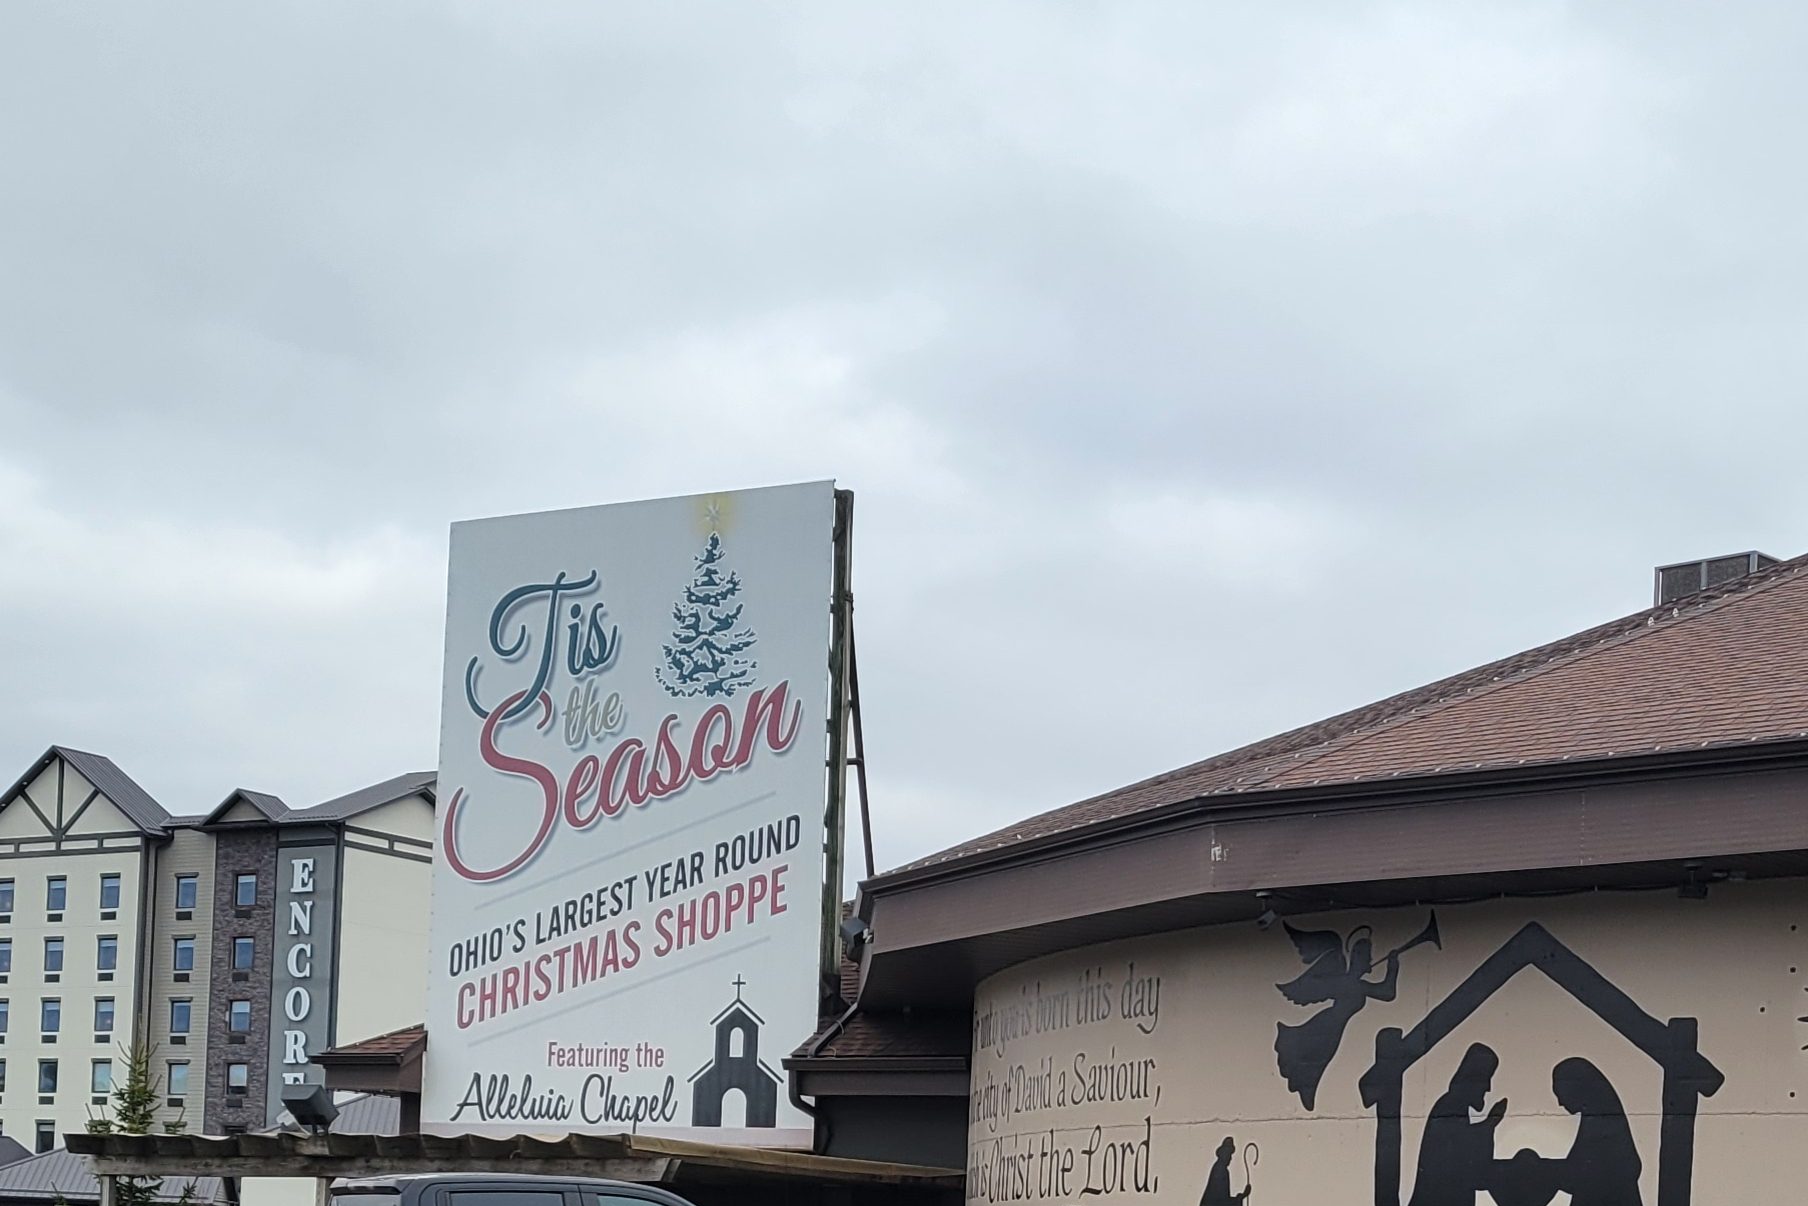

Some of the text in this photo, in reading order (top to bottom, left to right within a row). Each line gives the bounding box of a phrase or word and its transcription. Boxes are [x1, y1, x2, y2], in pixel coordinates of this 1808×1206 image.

[466, 569, 618, 720] Tis
[562, 677, 624, 746] the
[443, 679, 800, 881] Season
[449, 814, 801, 977] OHIO'S LARGEST YEAR ROUND
[456, 864, 789, 1029] CHRISTMAS SHOPPE
[1036, 981, 1070, 1034] born
[1077, 966, 1113, 1025] this
[1121, 961, 1160, 1034] day
[547, 1041, 664, 1073] Featuring the
[1001, 1065, 1014, 1123] of
[1014, 1055, 1052, 1113] David
[1057, 1070, 1067, 1107] a
[1071, 1045, 1161, 1107] Saviour,
[449, 1071, 678, 1134] Alleluia Chapel
[988, 1132, 1034, 1204] Christ
[1039, 1127, 1074, 1199] the
